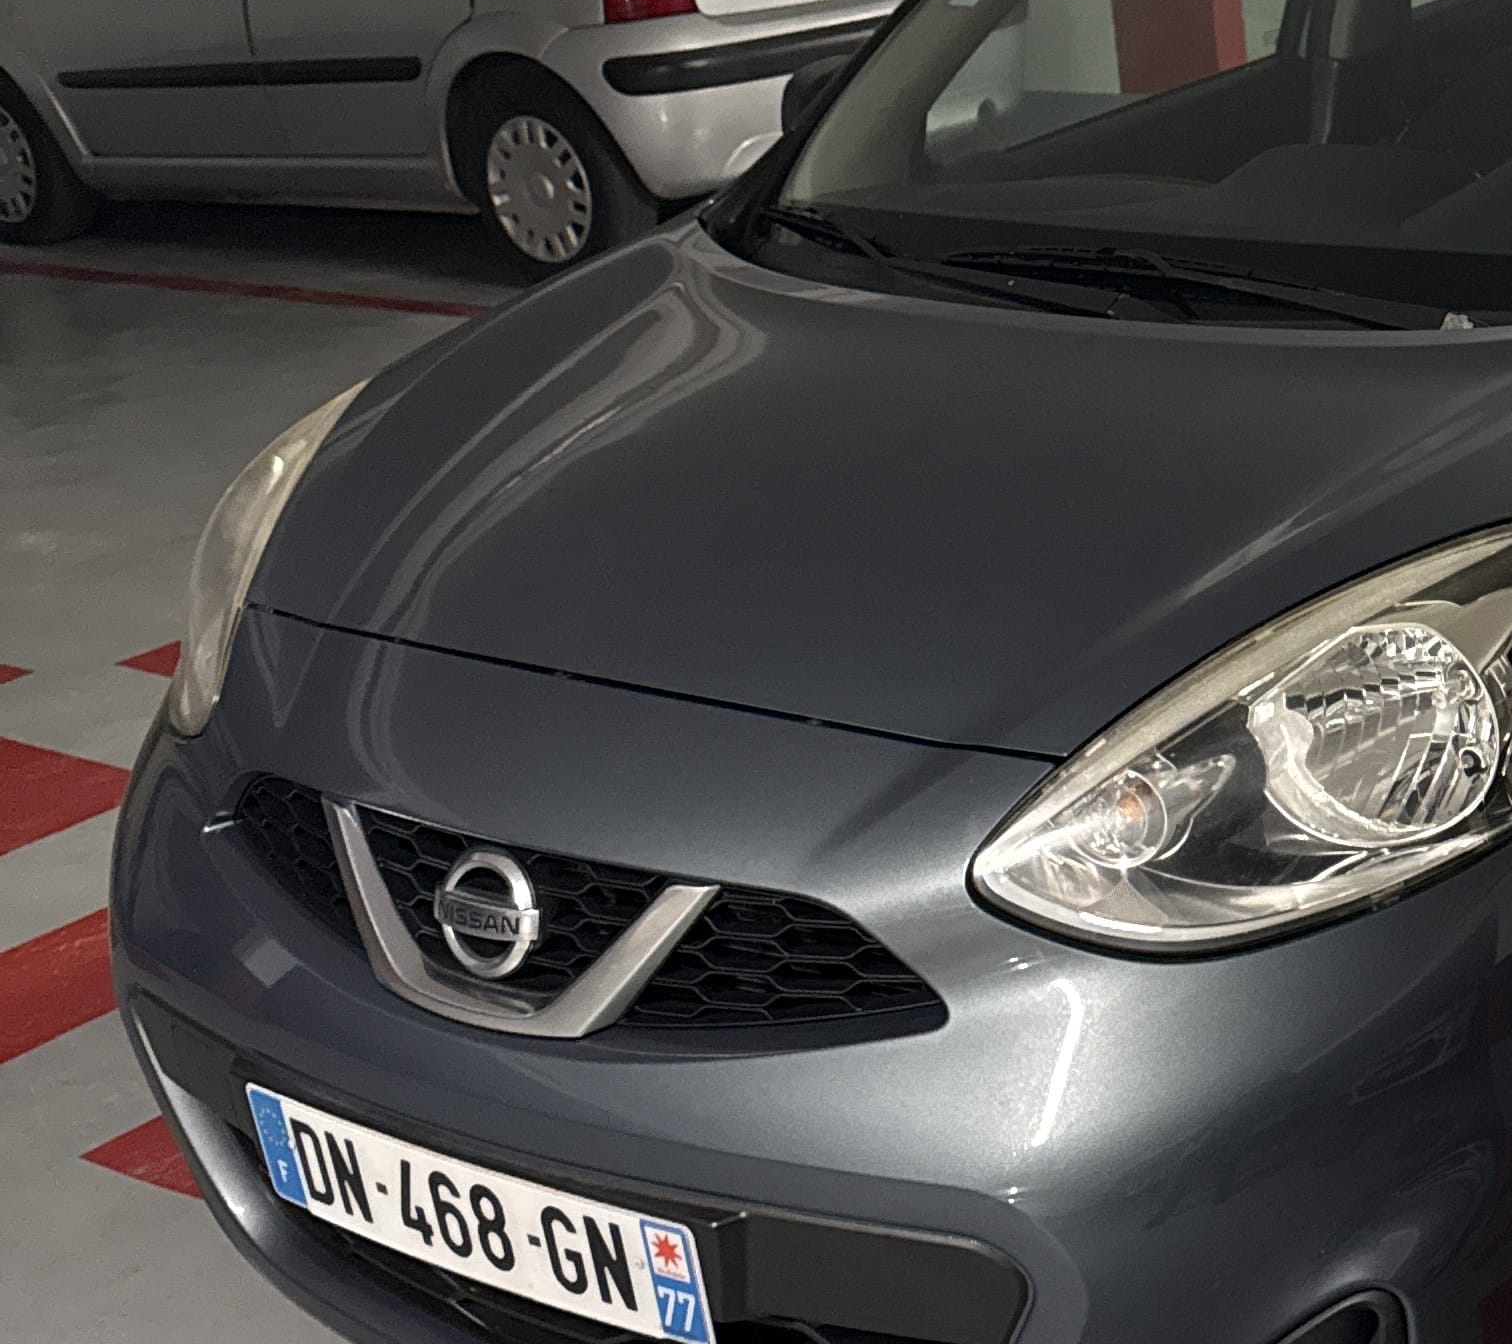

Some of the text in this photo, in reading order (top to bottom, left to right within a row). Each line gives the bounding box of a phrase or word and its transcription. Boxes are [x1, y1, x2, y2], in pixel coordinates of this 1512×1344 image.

[438, 899, 520, 936] NISSAN
[277, 1159, 288, 1183] F
[289, 1117, 638, 1311] DN-468-GN
[657, 1285, 696, 1333] 77
